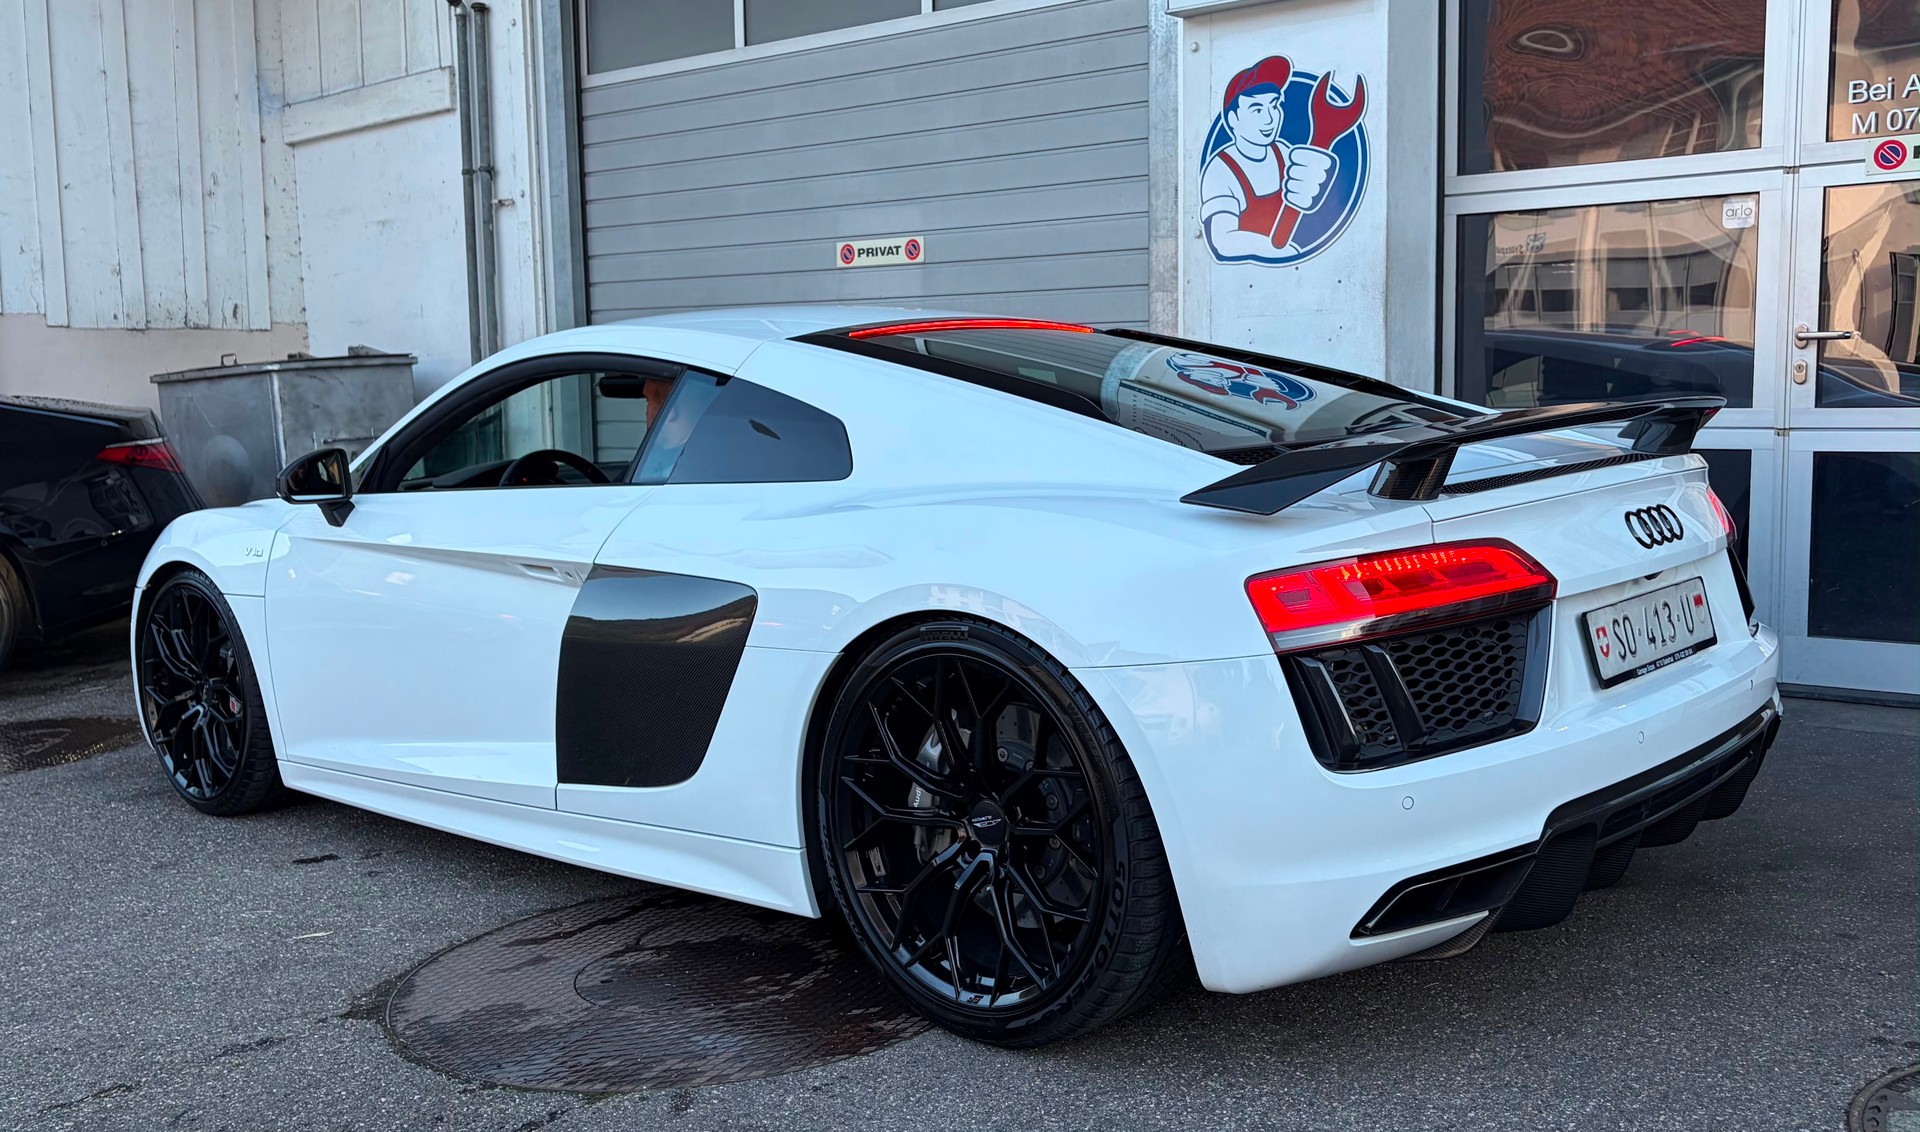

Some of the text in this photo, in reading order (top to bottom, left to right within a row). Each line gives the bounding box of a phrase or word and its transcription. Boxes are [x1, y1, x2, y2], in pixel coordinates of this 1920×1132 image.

[1848, 76, 1893, 104] Bei
[1852, 107, 1920, 135] M 07
[1725, 204, 1752, 217] arlo
[857, 245, 901, 258] PRIVAT
[913, 786, 921, 808] Audi
